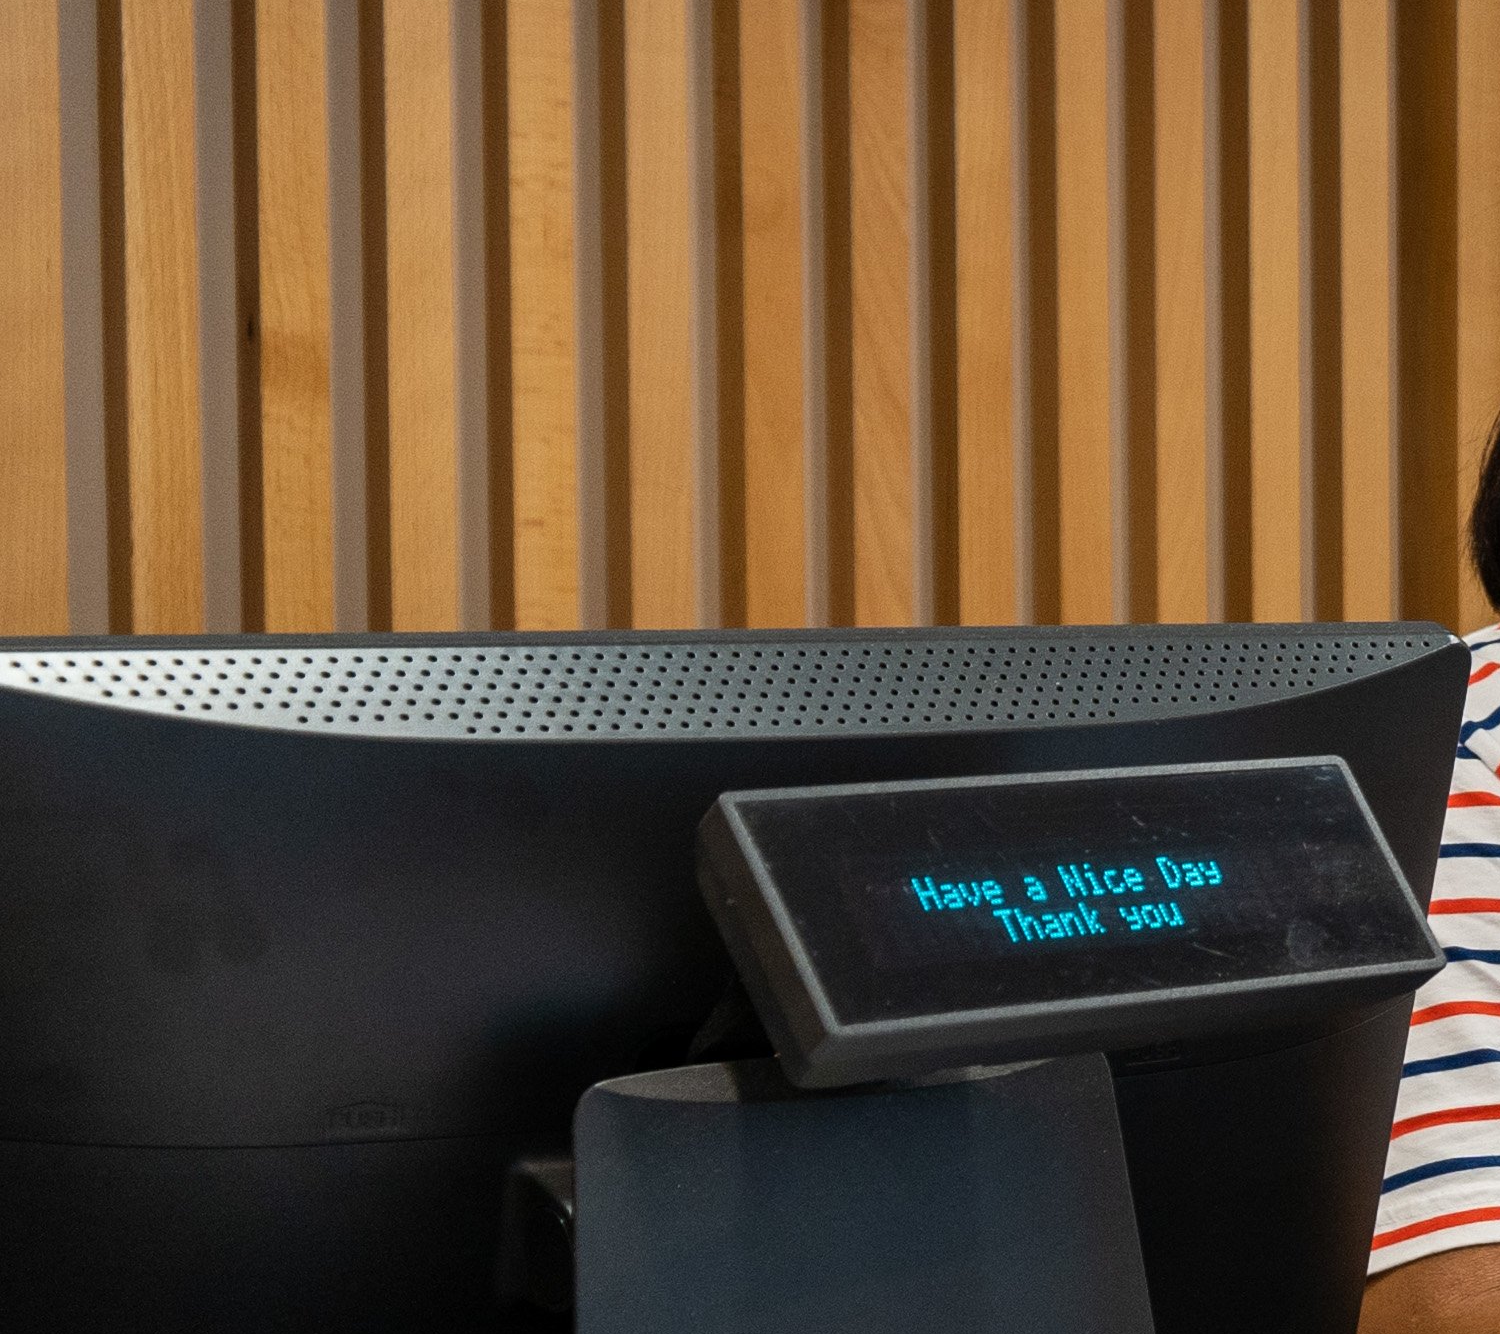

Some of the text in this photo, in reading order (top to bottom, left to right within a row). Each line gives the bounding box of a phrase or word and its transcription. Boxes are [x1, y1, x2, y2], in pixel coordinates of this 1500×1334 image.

[911, 855, 1223, 911] Have a Nice Day
[992, 901, 1186, 943] Thank you
